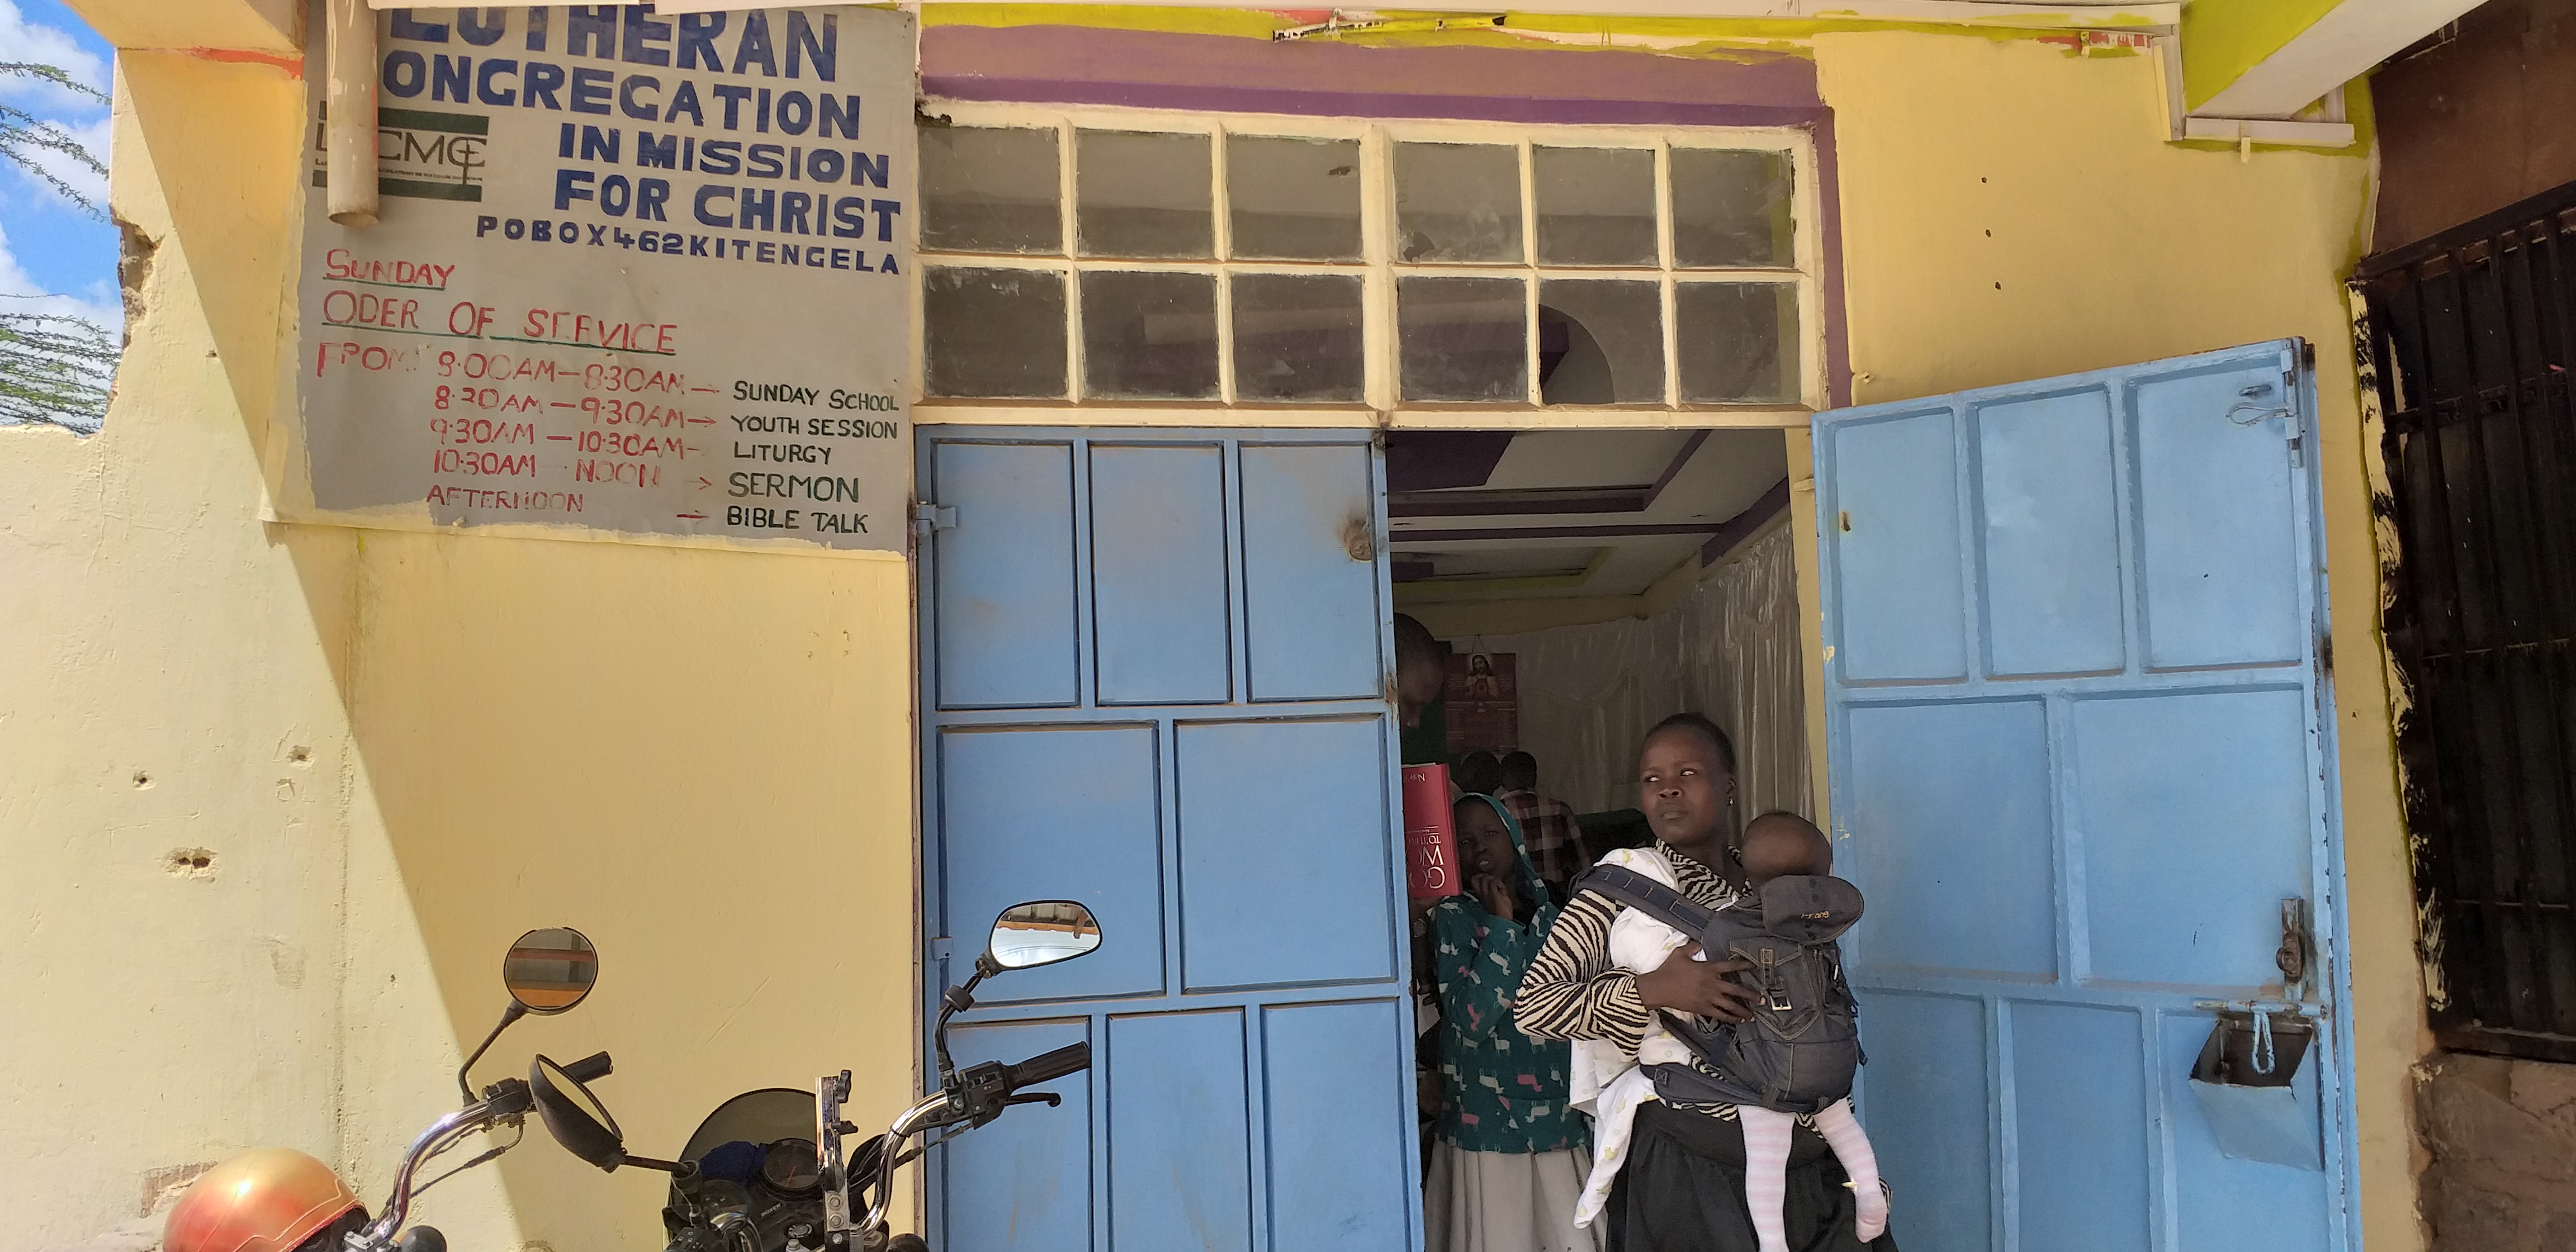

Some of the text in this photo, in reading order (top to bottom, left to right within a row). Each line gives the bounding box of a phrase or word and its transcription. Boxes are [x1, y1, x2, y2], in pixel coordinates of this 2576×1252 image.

[382, 49, 861, 140] ONGREGATION
[558, 122, 890, 189] IN MISSION
[554, 169, 901, 243] FOR CHRIST
[326, 249, 456, 287] SUNDAY
[323, 290, 419, 329] ODER
[448, 301, 496, 337] OF
[733, 381, 820, 406] SUNDAY
[828, 390, 900, 411] SCHOOL
[730, 416, 800, 435] YOUTH
[807, 419, 898, 439] SESSION
[733, 441, 832, 466] LITURGY
[727, 472, 859, 504] SERMON
[727, 506, 800, 529] BIBLE
[811, 511, 869, 534] TALK
[1428, 835, 1442, 845] TO
[1405, 845, 1444, 867] WO
[1408, 866, 1446, 889] GO
